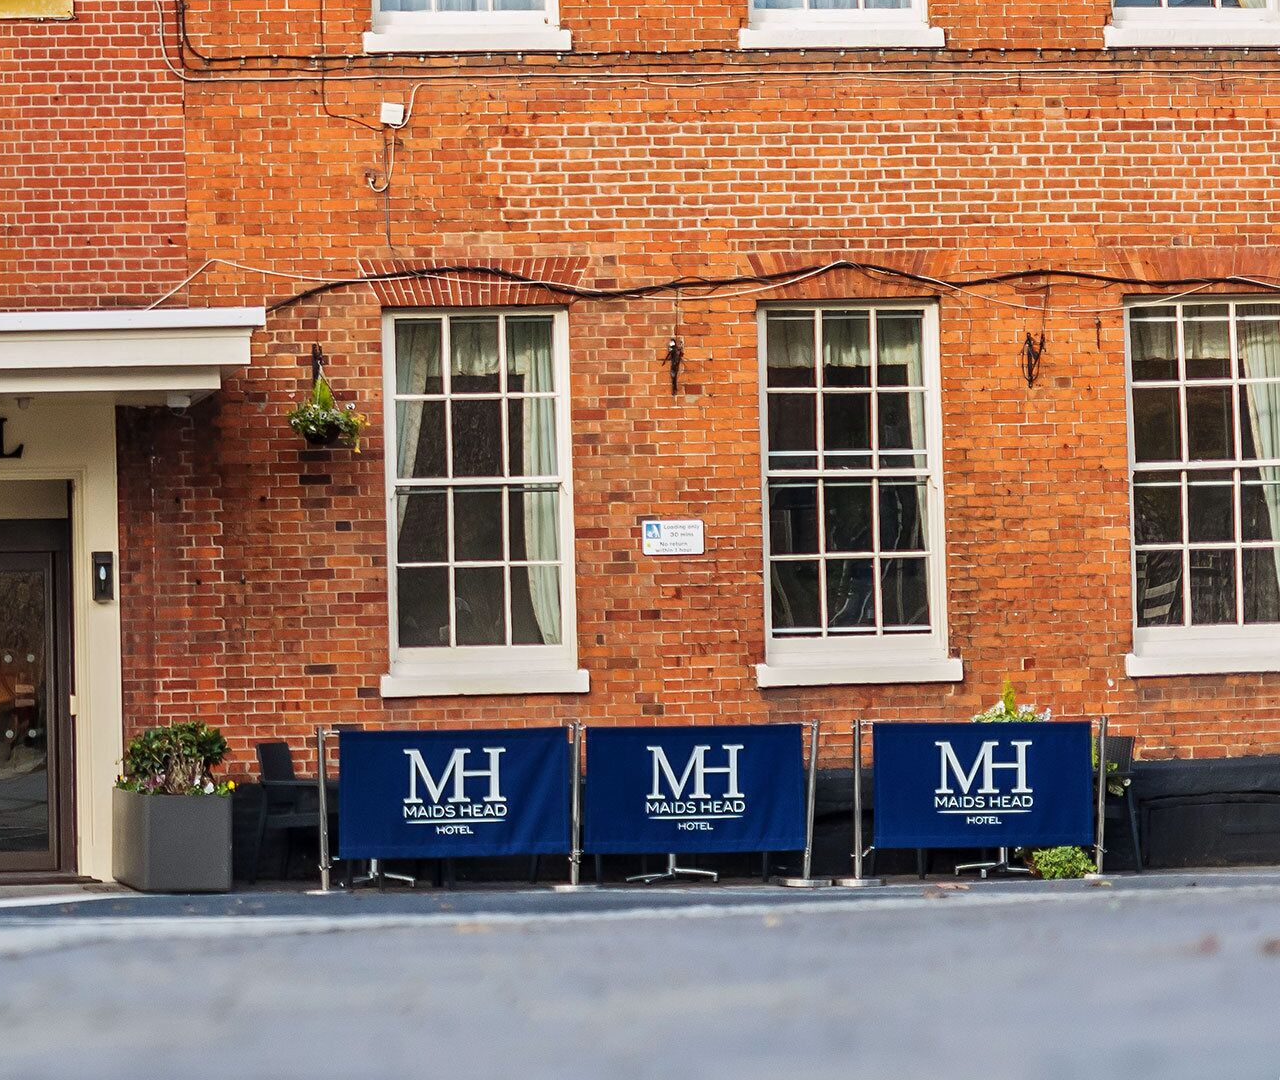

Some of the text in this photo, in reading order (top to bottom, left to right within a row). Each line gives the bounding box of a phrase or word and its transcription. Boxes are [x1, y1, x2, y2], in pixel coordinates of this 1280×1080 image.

[646, 745, 745, 800] MH
[935, 741, 1034, 794] MH
[403, 747, 507, 804] MH
[646, 801, 746, 814] MAIDS HEAD
[934, 796, 1034, 808] MAIDS HEAD
[403, 804, 508, 818] MAIDS HEAD
[678, 822, 714, 831] HOTEL
[966, 816, 1002, 825] HOTEL
[436, 825, 474, 835] HOTEL
